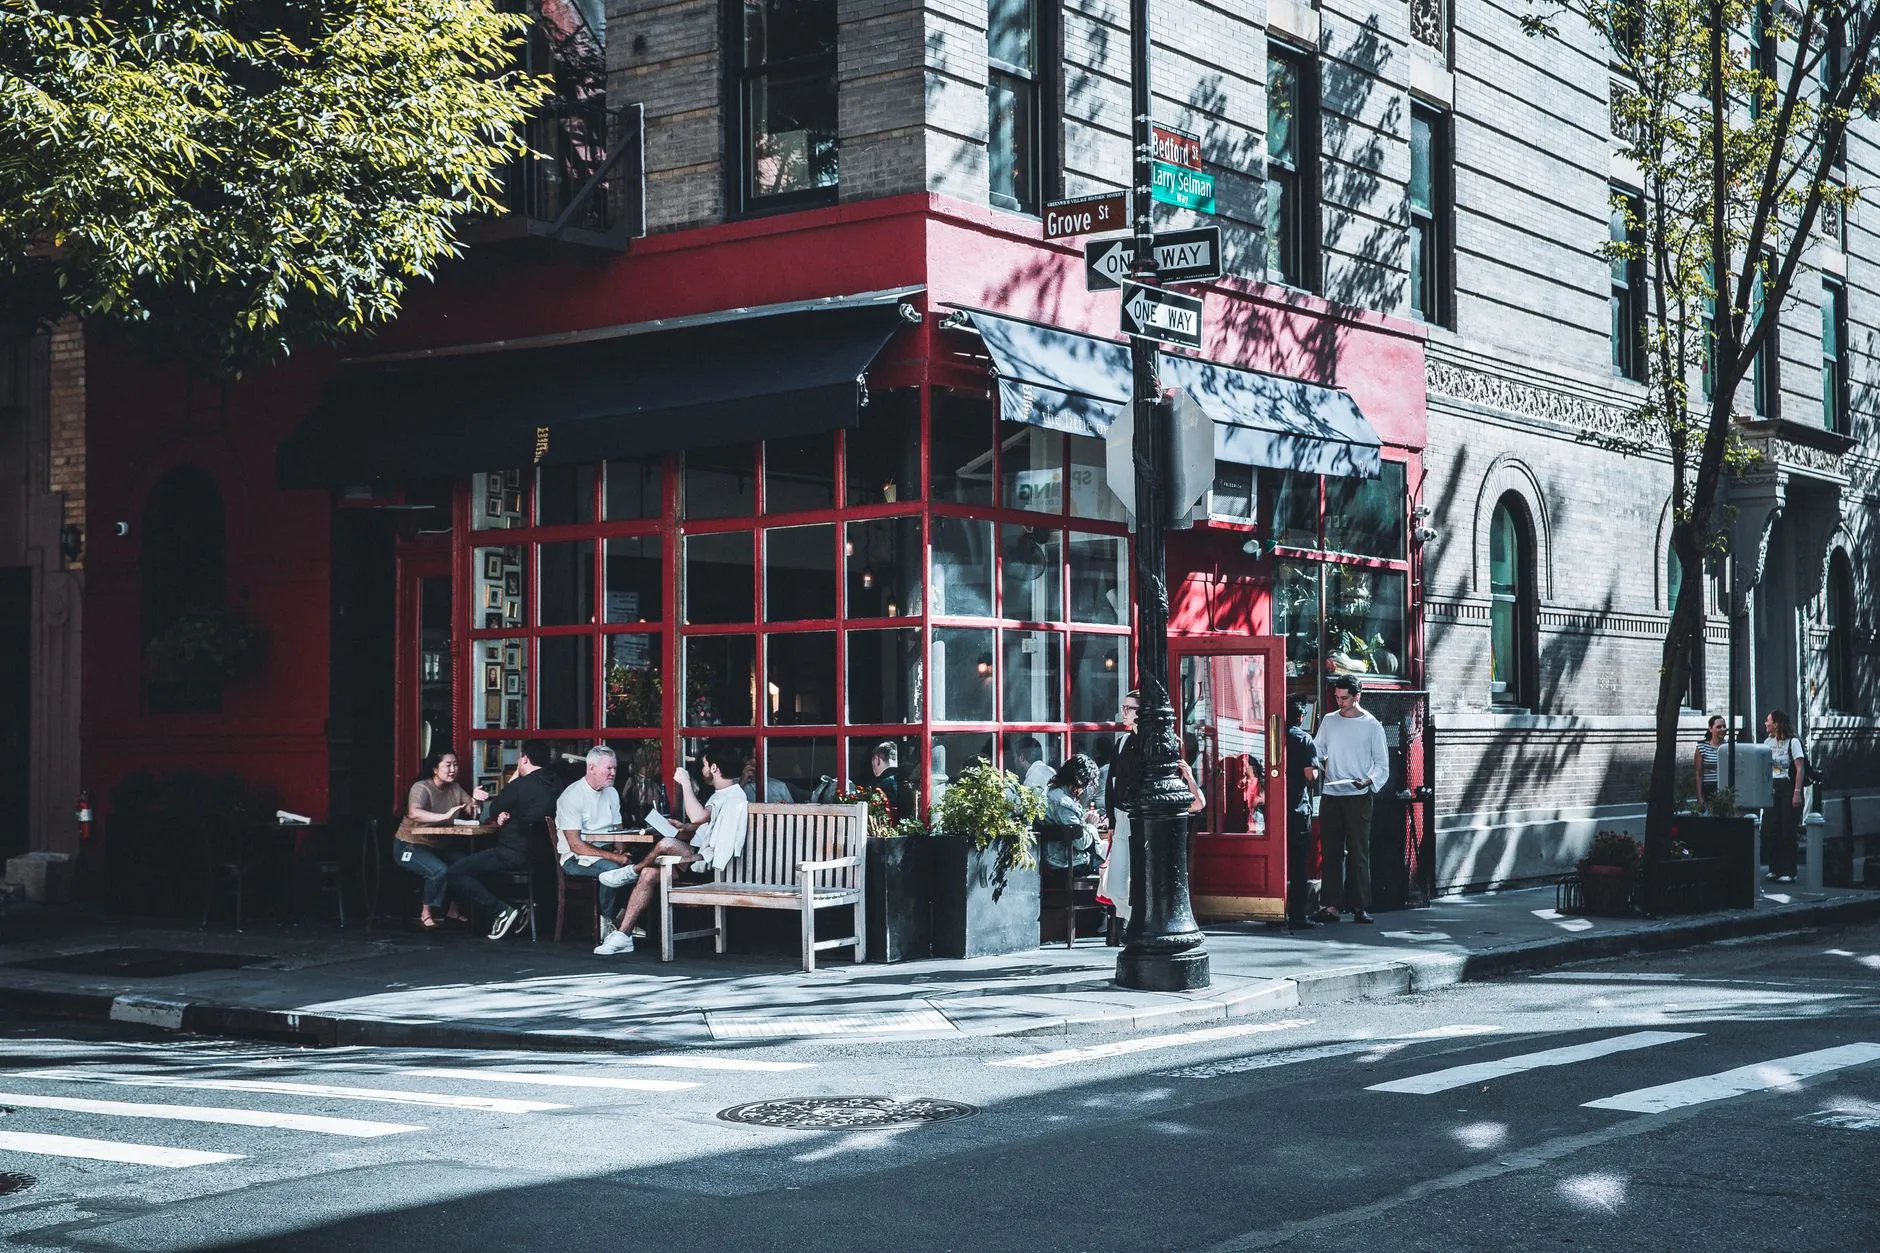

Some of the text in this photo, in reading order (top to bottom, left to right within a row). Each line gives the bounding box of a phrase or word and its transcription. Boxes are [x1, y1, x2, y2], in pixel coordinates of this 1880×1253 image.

[1152, 132, 1199, 165] Bedford St
[1153, 165, 1212, 198] Larry Selman
[1176, 192, 1189, 207] Way
[1047, 204, 1109, 236] Grove St
[1106, 244, 1202, 273] ON WAY
[1134, 300, 1193, 332] ONE WAY
[1042, 405, 1061, 426] the
[1064, 409, 1093, 433] little
